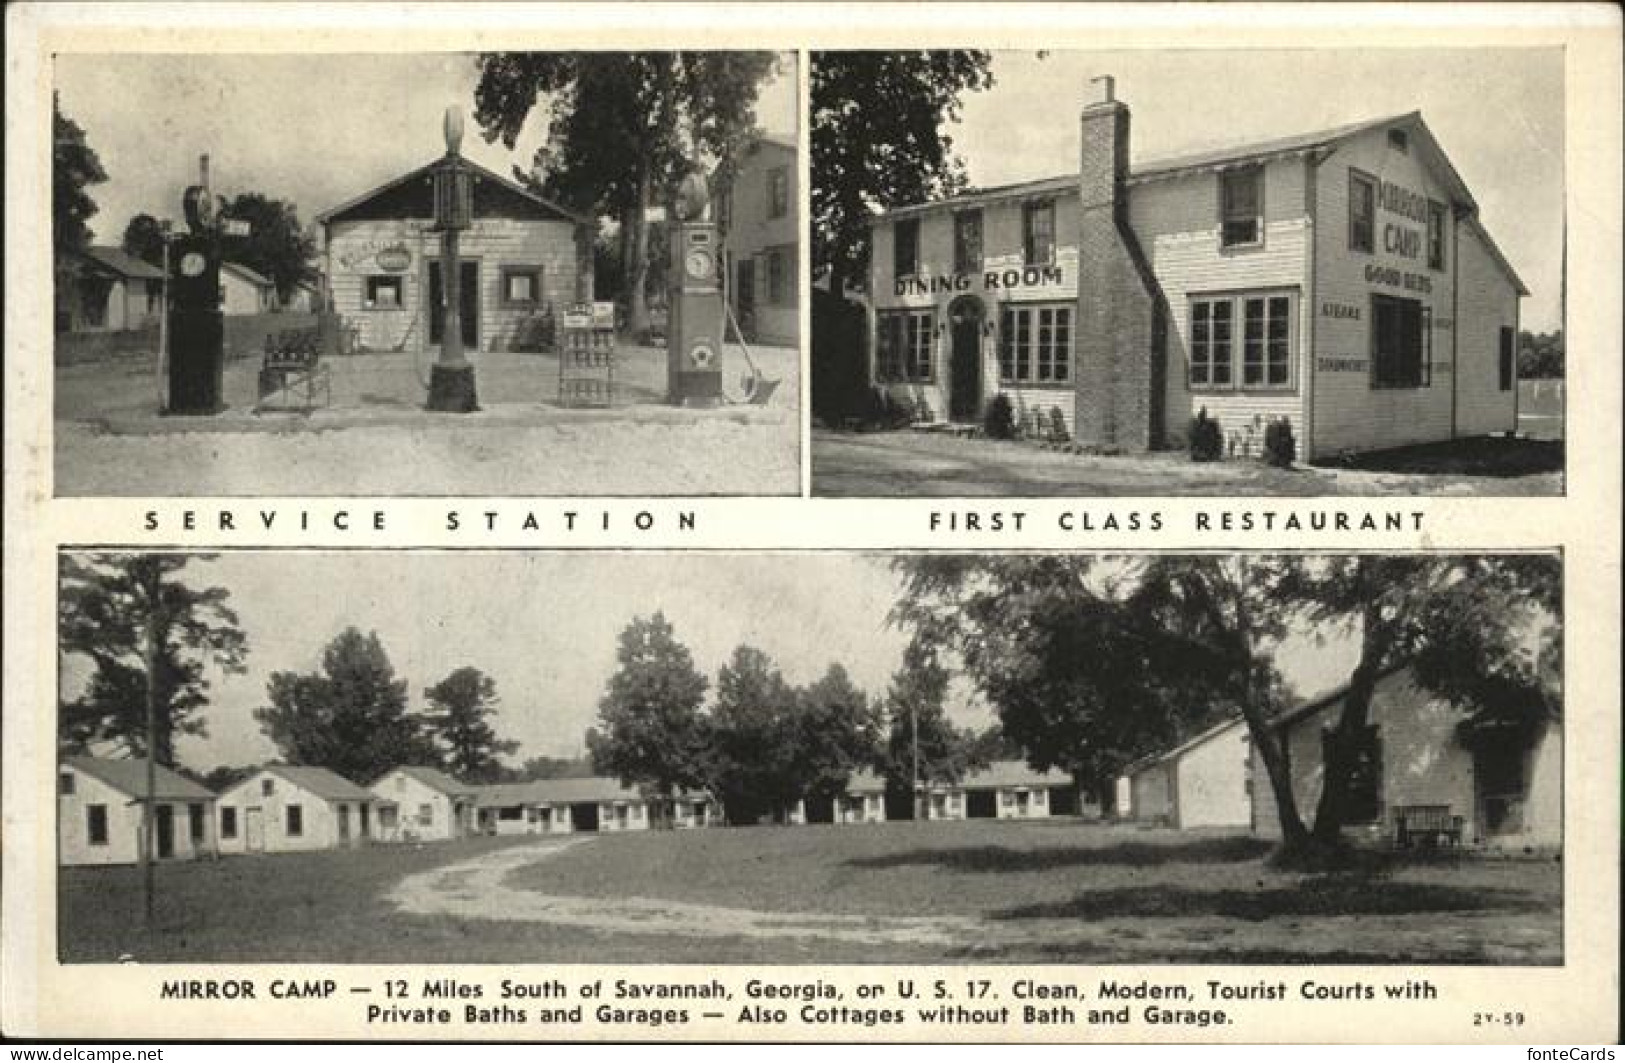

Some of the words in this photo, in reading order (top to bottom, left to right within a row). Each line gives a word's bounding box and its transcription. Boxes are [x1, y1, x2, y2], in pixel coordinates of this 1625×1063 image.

[1378, 181, 1427, 223] MIRROR
[1385, 223, 1422, 259] CAMP
[894, 275, 972, 297] DINING
[984, 267, 1063, 290] ROOM
[1364, 264, 1401, 287] GOOD
[144, 510, 386, 531] SERVICE
[446, 511, 698, 531] STATION
[929, 512, 1026, 531] FIRST
[1057, 512, 1164, 531] CLASS
[1196, 512, 1427, 532] RESTAURANT
[160, 980, 255, 998] MIRROR
[270, 980, 337, 998] CAMP
[385, 980, 409, 998] 12
[423, 979, 484, 998] Miles
[501, 979, 567, 998] South
[579, 979, 602, 998] of
[615, 980, 733, 1001] Savannah,
[746, 980, 848, 1003] Georgia,
[898, 980, 920, 999] U.
[934, 980, 953, 999] S.
[966, 980, 999, 999] 17.
[1012, 980, 1085, 1001] Clean,
[1099, 981, 1195, 1002] Modern,
[1206, 981, 1286, 1000] Tourist
[1301, 981, 1376, 1000] Courts
[1385, 981, 1438, 1000] with
[367, 1005, 451, 1024] Private
[465, 1005, 527, 1024] Baths
[540, 1005, 582, 1024] and
[596, 1005, 689, 1027] Garages
[737, 1005, 788, 1024] Also
[800, 1005, 905, 1027] Cottages
[918, 1005, 1009, 1024] without
[1023, 1005, 1075, 1024] Bath
[1088, 1006, 1130, 1024] and
[1143, 1006, 1233, 1027] Garage.
